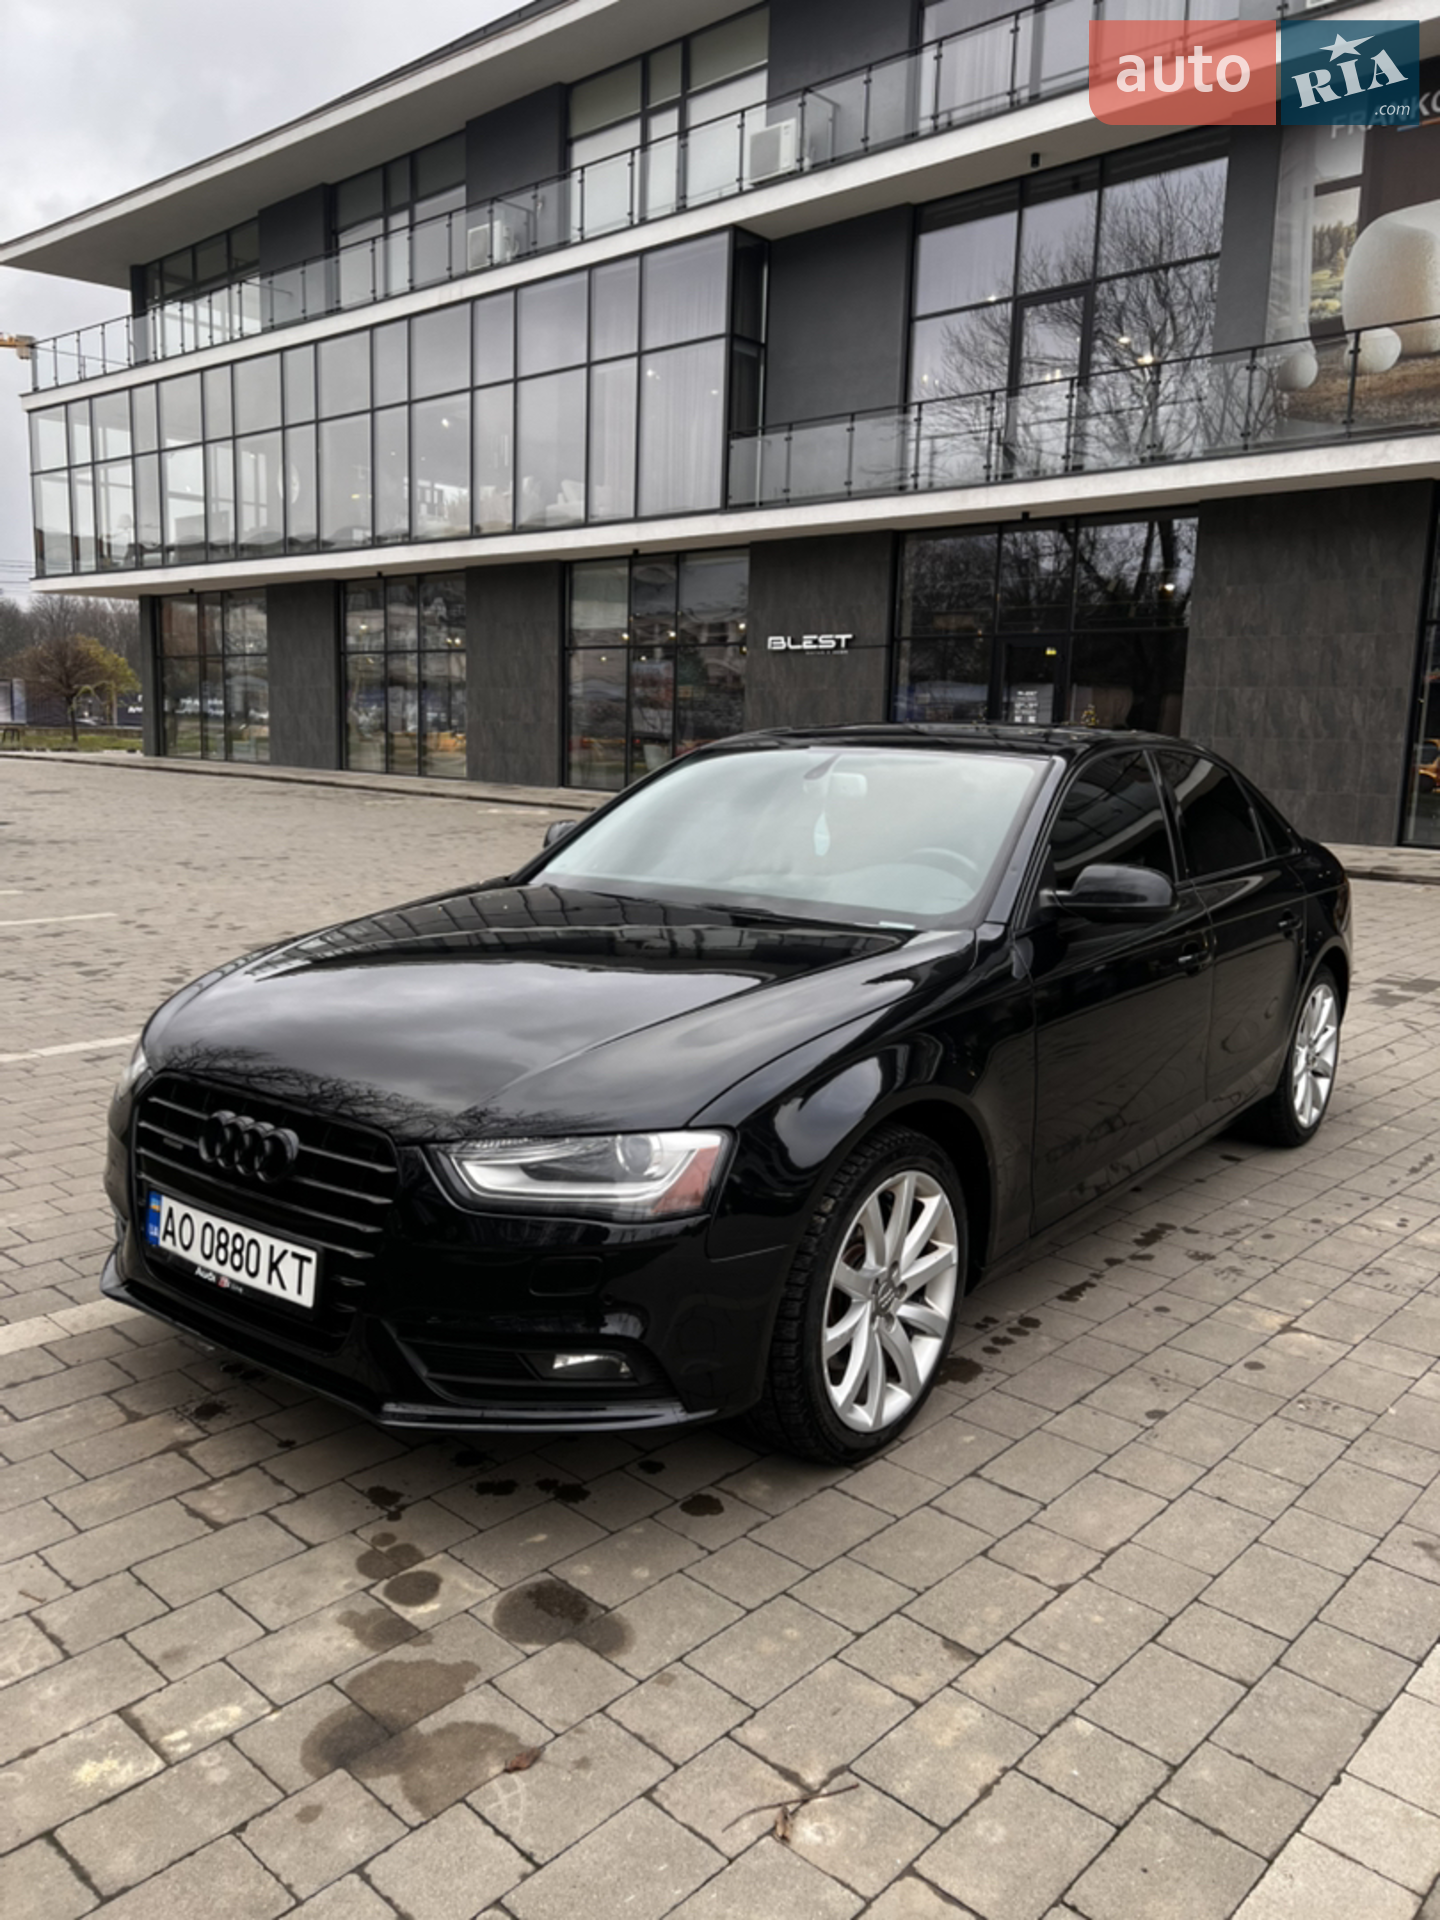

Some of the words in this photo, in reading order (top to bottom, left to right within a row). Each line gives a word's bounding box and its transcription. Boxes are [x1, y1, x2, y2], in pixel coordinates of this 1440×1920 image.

[767, 633, 853, 650] BLEST
[162, 1206, 195, 1251] AO
[200, 1222, 261, 1279] 0880
[267, 1244, 312, 1296] KT
